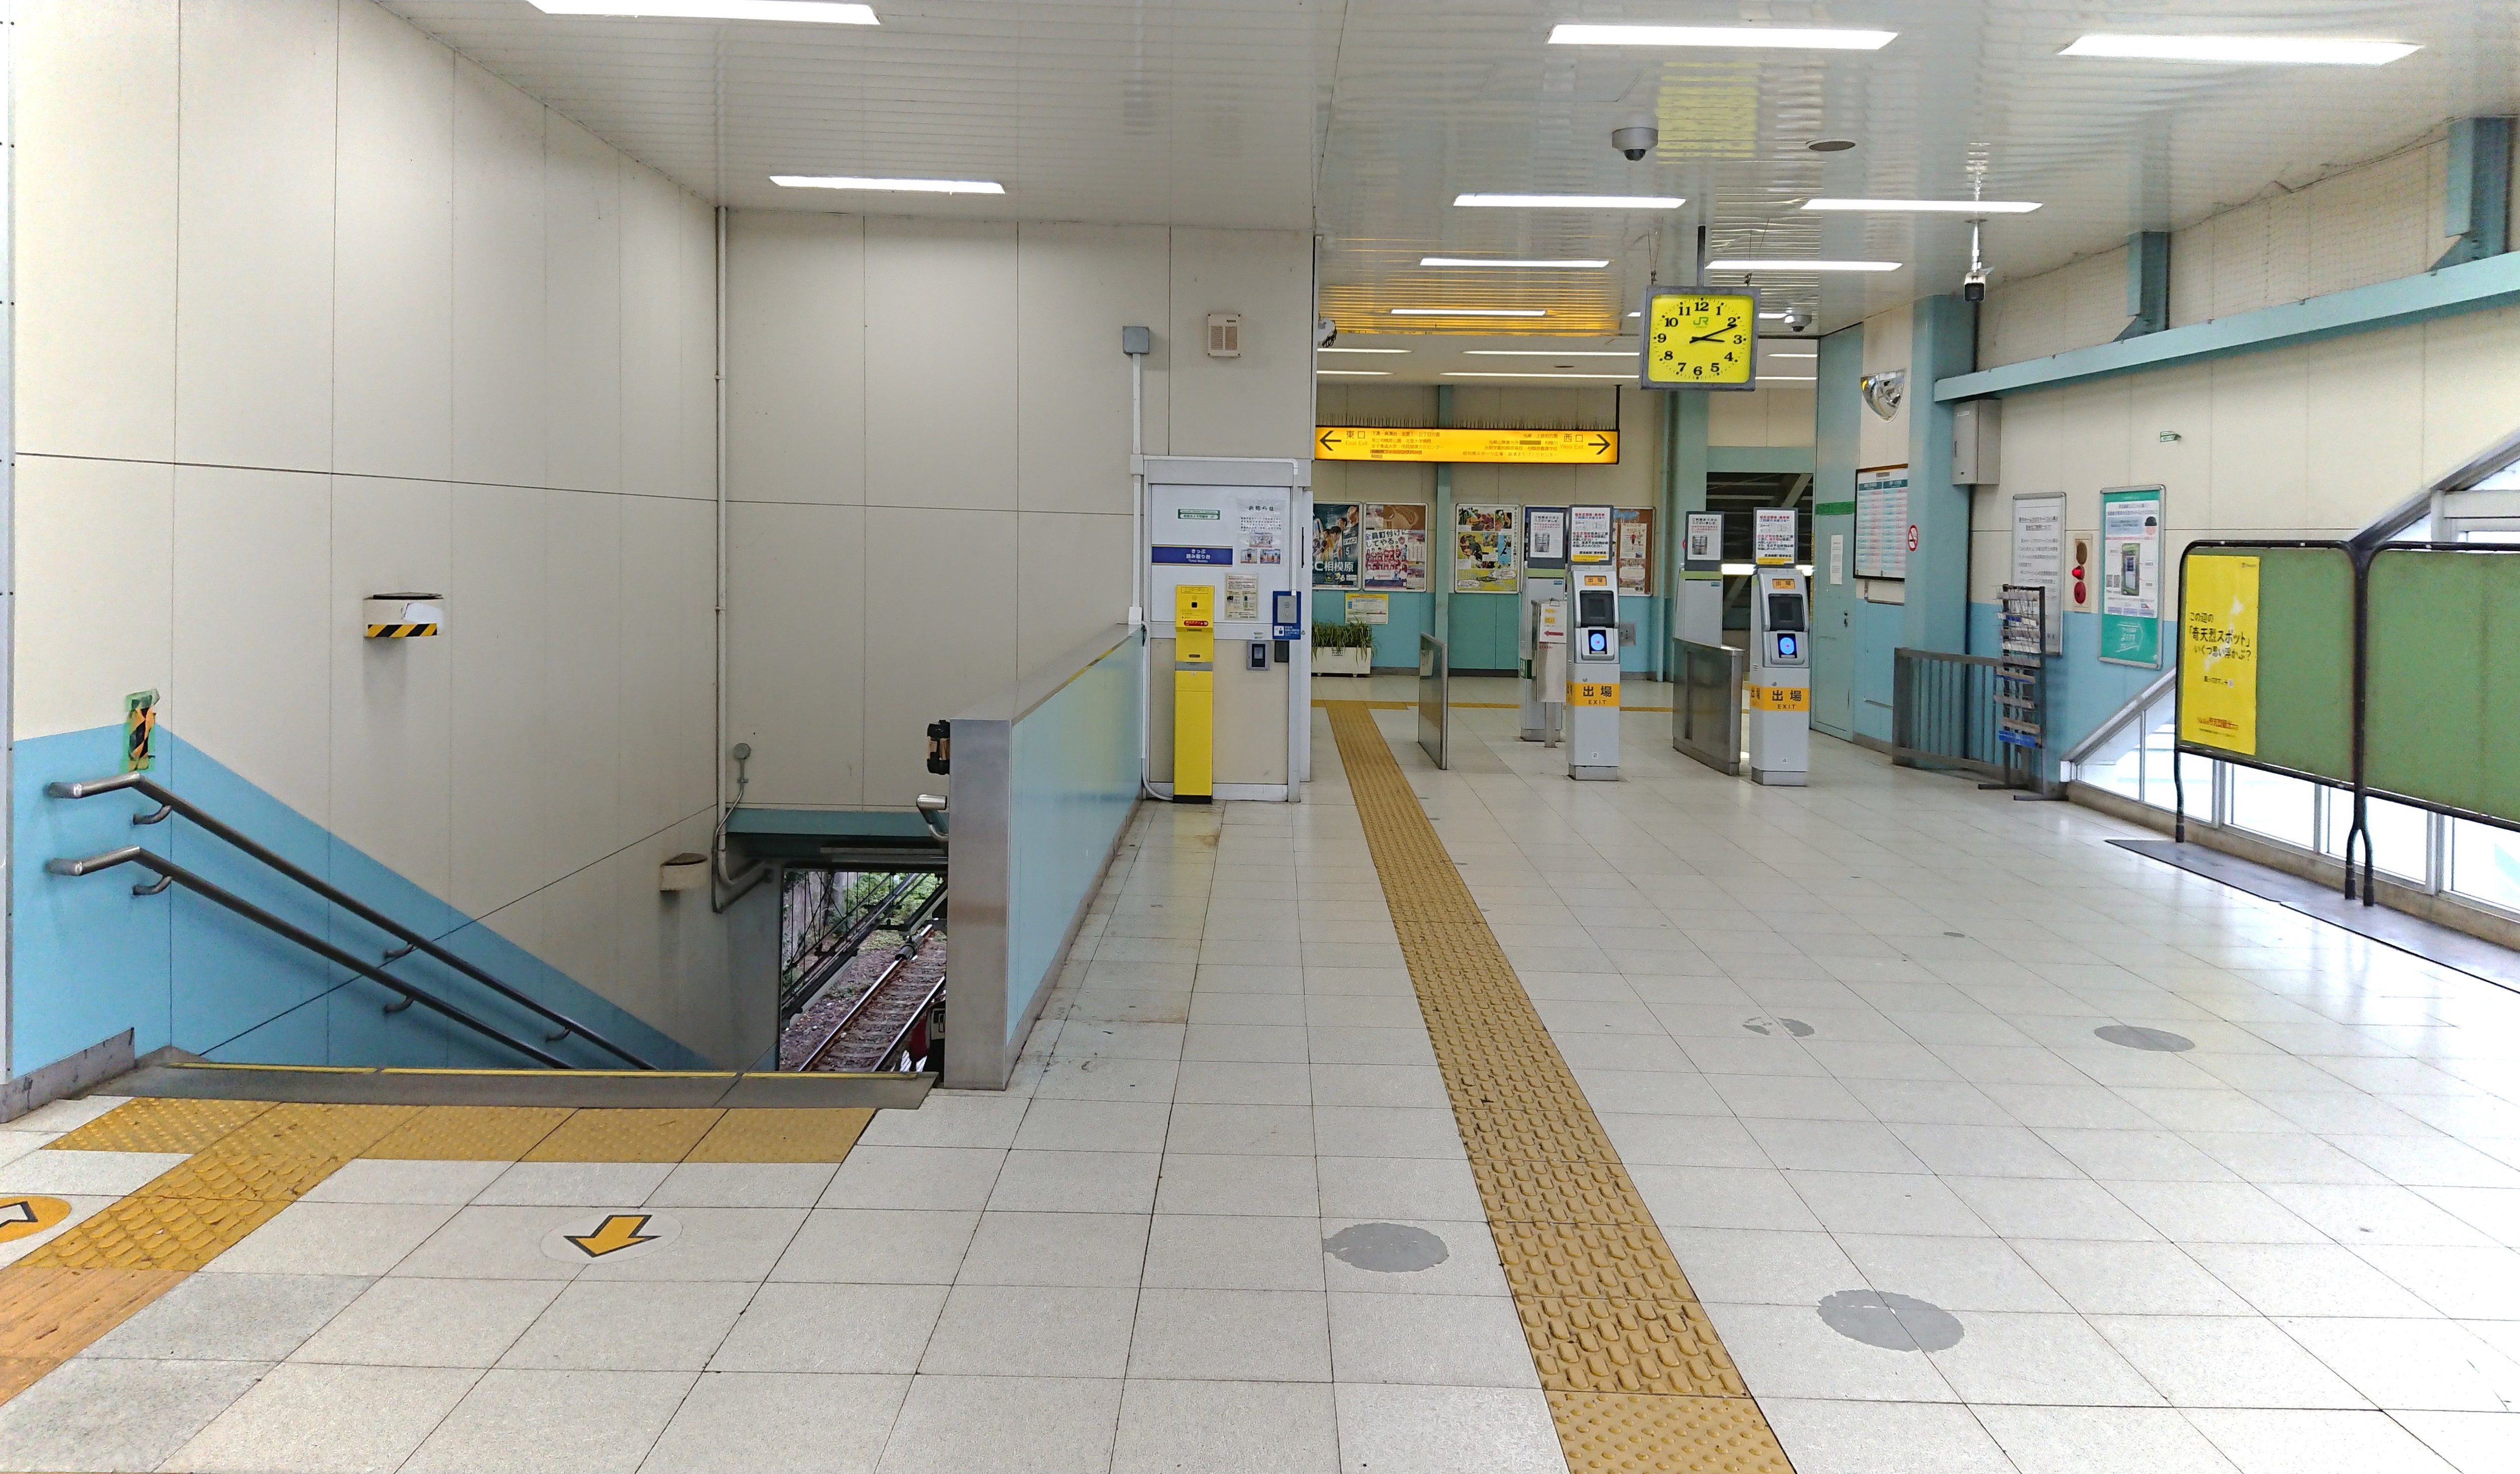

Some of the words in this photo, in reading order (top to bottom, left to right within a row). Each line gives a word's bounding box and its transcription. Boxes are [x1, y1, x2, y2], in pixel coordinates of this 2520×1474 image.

[1679, 306, 1690, 315] 11
[1694, 302, 1709, 311] 12
[1716, 306, 1721, 315] 1
[1665, 317, 1678, 327] 10
[1693, 316, 1709, 325] JR
[1727, 317, 1736, 327] 2
[1658, 333, 1666, 343] 9
[1733, 335, 1742, 344] 3
[1664, 351, 1673, 360] 8
[1724, 352, 1734, 361] 4
[1678, 362, 1686, 372] 7
[1693, 366, 1703, 376] 6
[1711, 363, 1720, 372] 5
[1345, 430, 1365, 439] 東口
[1563, 433, 1583, 442] 西口
[1365, 530, 1409, 541] 全員釘付けに
[1366, 538, 1399, 548] してやる。
[1345, 547, 1350, 555] 5
[2190, 612, 2214, 623] この辺の
[2189, 625, 2250, 648] 「奇天烈スポット」
[1583, 685, 1612, 697] 出場
[1772, 690, 1802, 701] 出場
